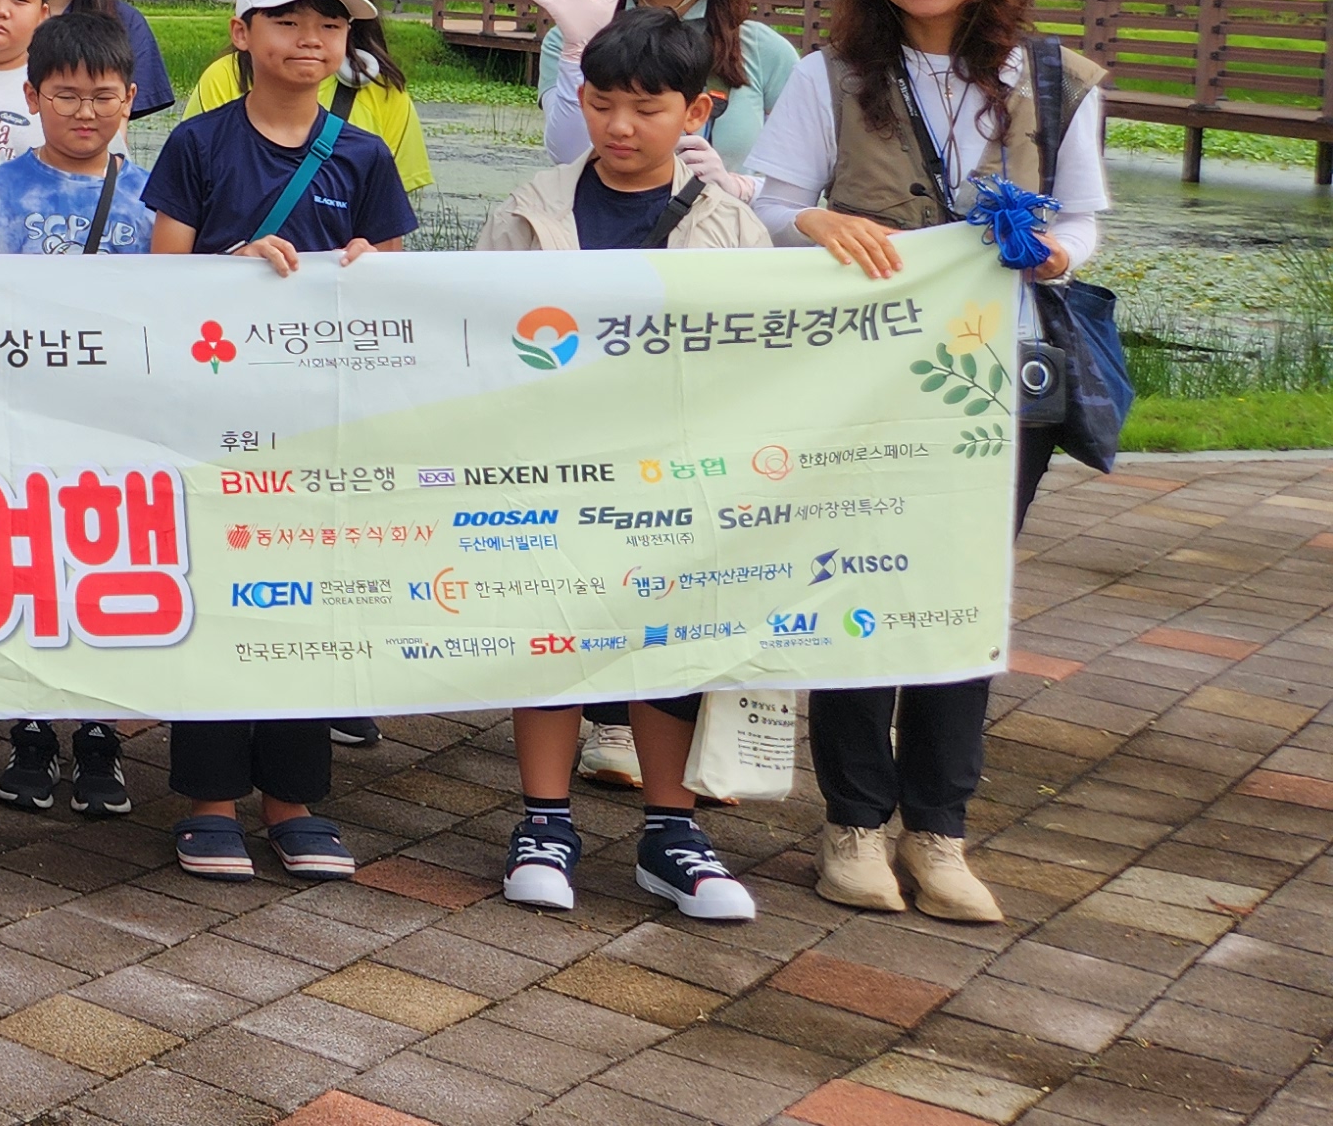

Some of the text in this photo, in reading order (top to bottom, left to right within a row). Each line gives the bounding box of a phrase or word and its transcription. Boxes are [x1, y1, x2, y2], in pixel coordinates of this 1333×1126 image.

[244, 318, 415, 355] 사랑의열매
[596, 298, 923, 356] 경상남도환경재단
[220, 431, 259, 452] 후원
[798, 443, 930, 470] 한화에어로스페이스
[464, 463, 615, 485] NEXEN TIRE
[669, 457, 727, 480] 농협
[221, 466, 396, 494] BNK 경남은행
[453, 509, 559, 527] DOOSAN
[578, 506, 693, 531] SEBANG
[794, 497, 906, 521] 세아창원특수강
[255, 524, 433, 547] 동서식품주식회사
[459, 533, 559, 553] 두산에너빌리티
[625, 532, 695, 548] 세방전지(주)
[841, 553, 909, 575] KISCO
[320, 579, 392, 595] 한국남동발전
[475, 577, 606, 598] 한국세라믹기술원
[631, 563, 793, 598] 캠코 한국자산관리공사
[232, 581, 313, 609] KOEN
[322, 595, 393, 606] KOREA ENERGY
[769, 612, 818, 633] KAI
[881, 606, 980, 631] 주택관리공단
[385, 637, 423, 645] HYUNDAI
[674, 621, 747, 642] 해성디에스
[235, 641, 373, 662] 한국토지주택공사
[444, 637, 516, 657] 현대위아
[580, 635, 627, 652] 복지재단
